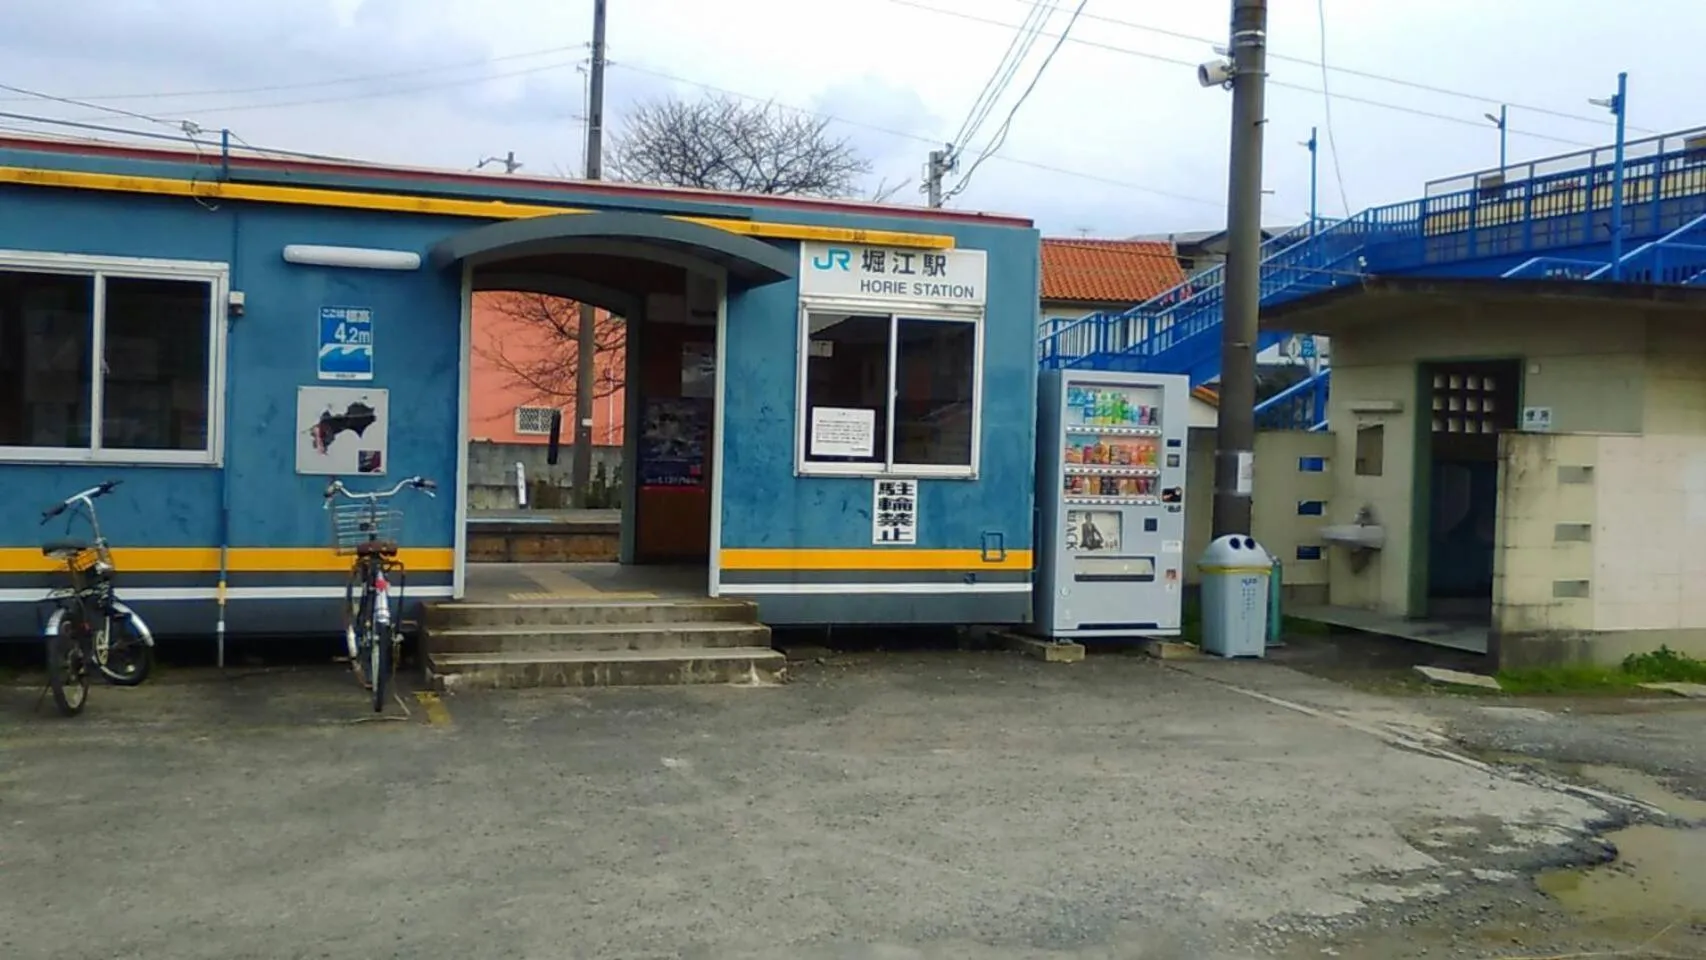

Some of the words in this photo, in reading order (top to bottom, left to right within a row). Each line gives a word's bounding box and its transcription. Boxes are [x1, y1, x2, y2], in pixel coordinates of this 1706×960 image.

[813, 248, 851, 271] JR
[861, 249, 946, 277] 堀江駅
[860, 280, 907, 294] HORIE
[913, 283, 974, 298] STATION
[334, 322, 369, 342] 4.2m
[877, 482, 914, 542] 駐輪禁止
